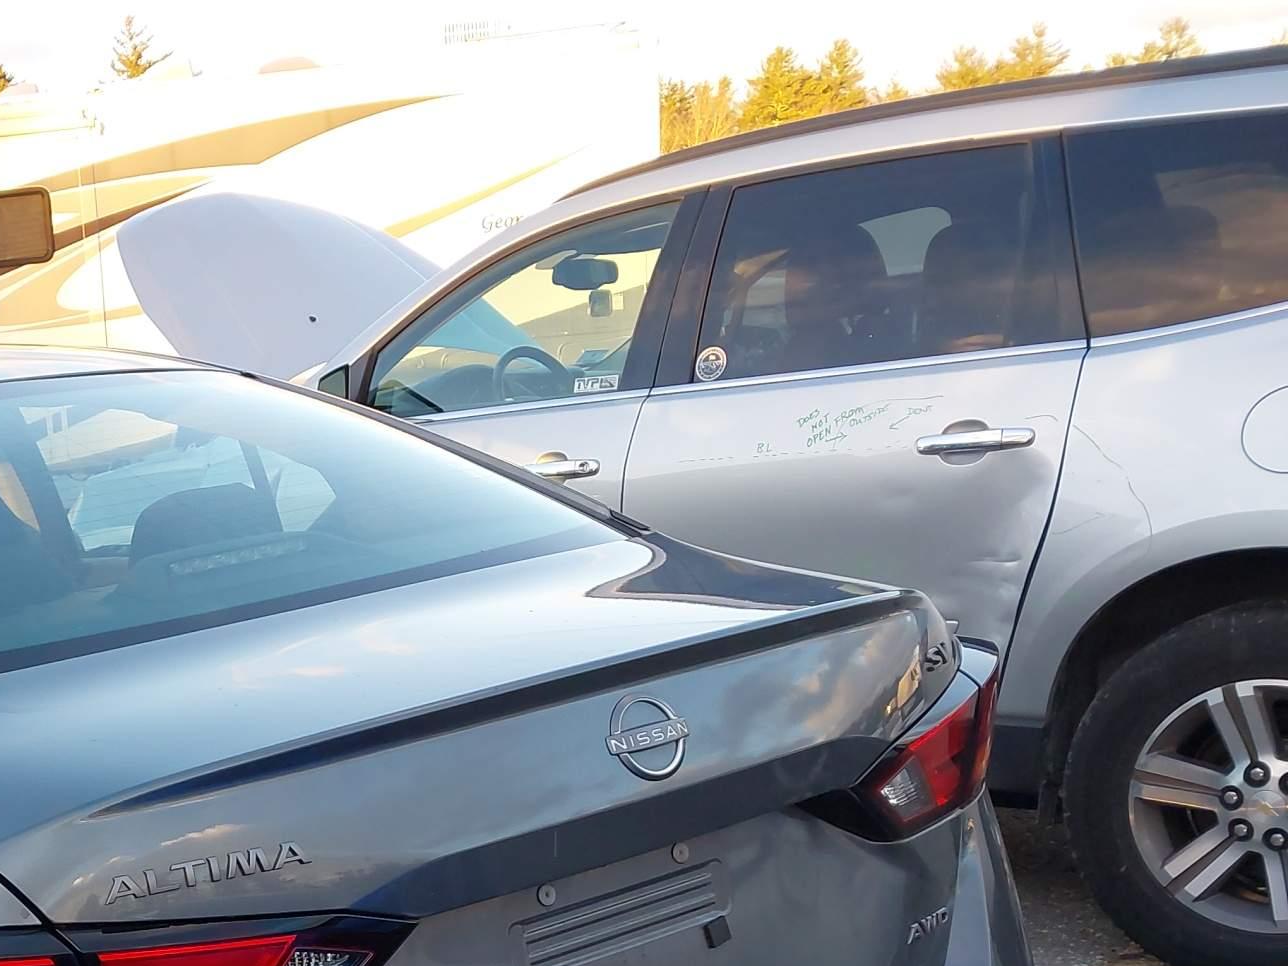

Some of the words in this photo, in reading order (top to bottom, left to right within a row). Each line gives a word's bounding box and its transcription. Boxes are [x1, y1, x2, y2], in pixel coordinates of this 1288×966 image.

[797, 408, 820, 428] DOES
[811, 412, 831, 433] NOT
[833, 406, 865, 428] FROM
[806, 425, 832, 448] OPEN
[610, 721, 688, 752] NISSAN
[104, 840, 312, 905] ALTIMA
[907, 906, 949, 945] AWD
